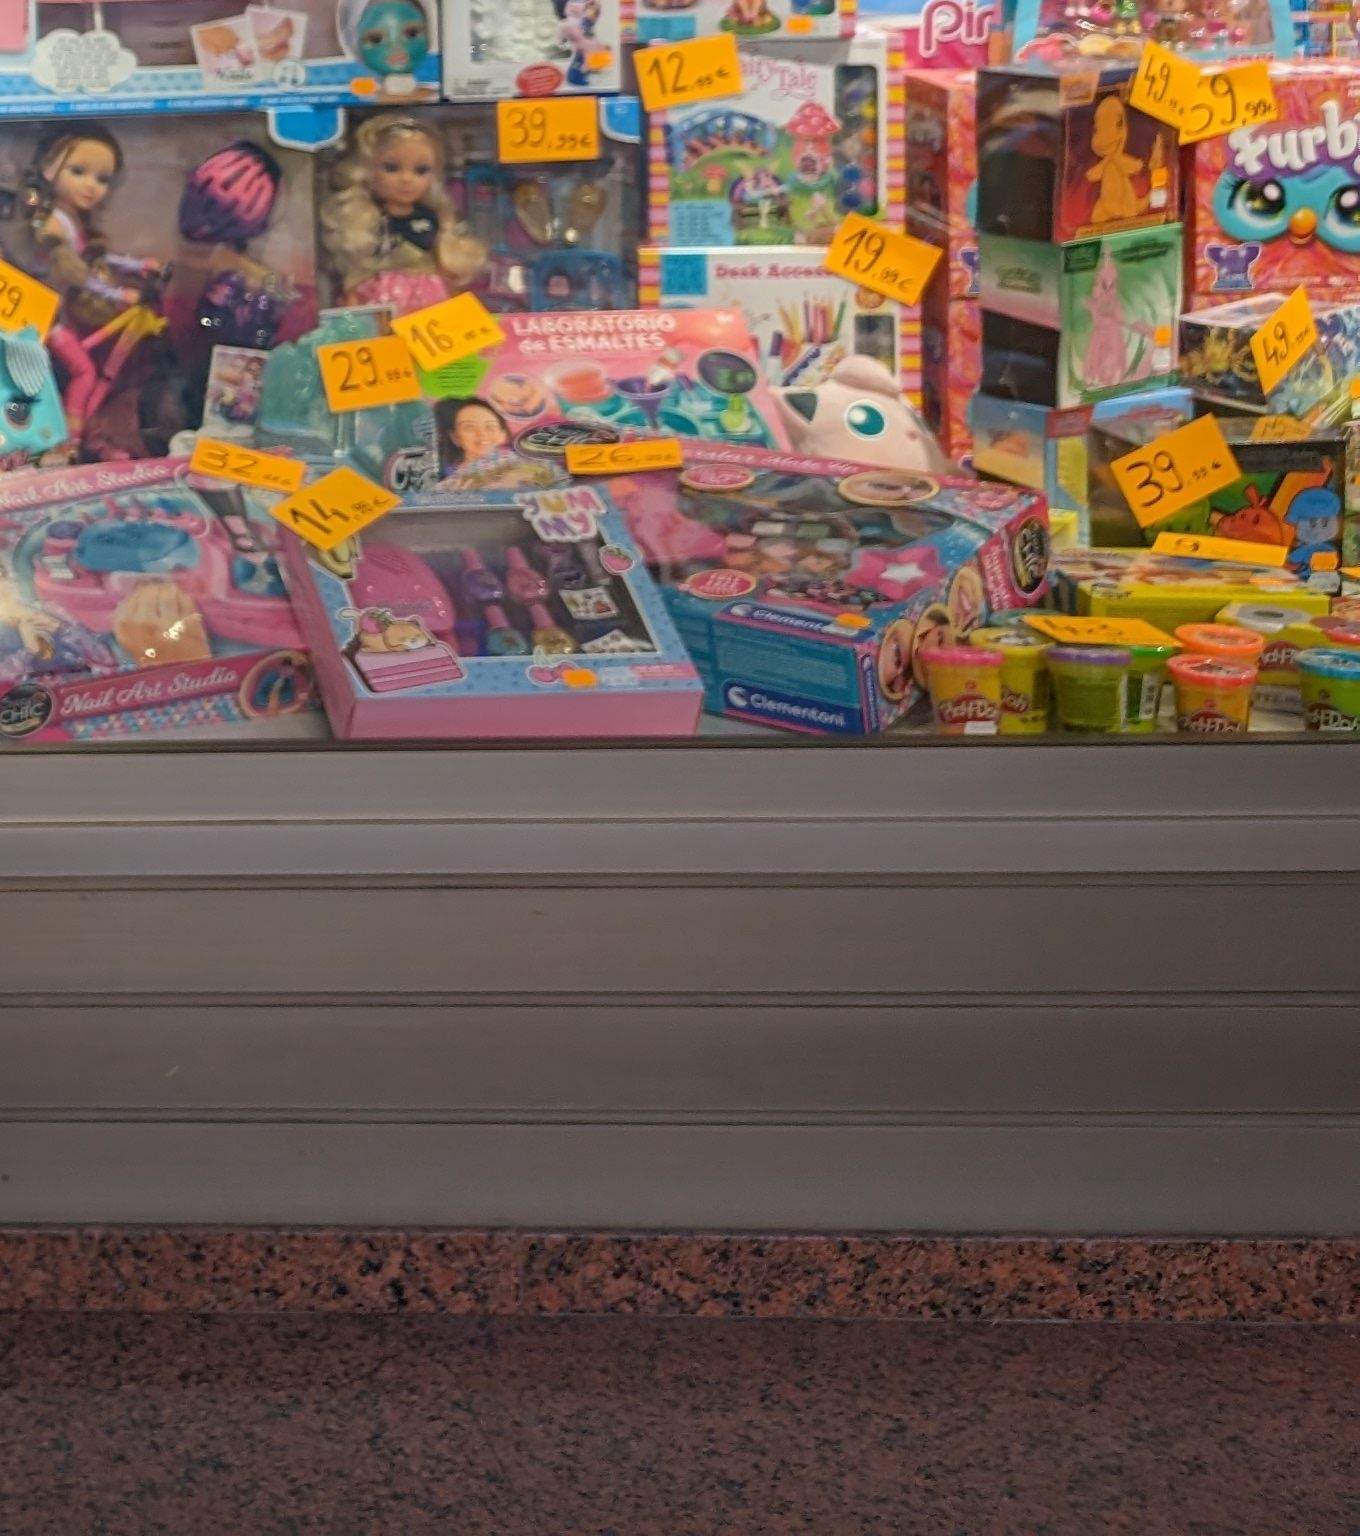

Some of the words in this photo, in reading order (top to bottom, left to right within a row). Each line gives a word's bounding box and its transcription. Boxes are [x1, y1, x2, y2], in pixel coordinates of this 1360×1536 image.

[1228, 99, 1360, 176] Furb
[511, 313, 677, 336] LABORATORIO
[518, 338, 546, 355] de
[549, 332, 666, 352] ESMALTES
[60, 688, 114, 715] Nail
[117, 681, 162, 704] Art
[168, 667, 237, 693] Studio
[749, 693, 847, 729] Clementoni
